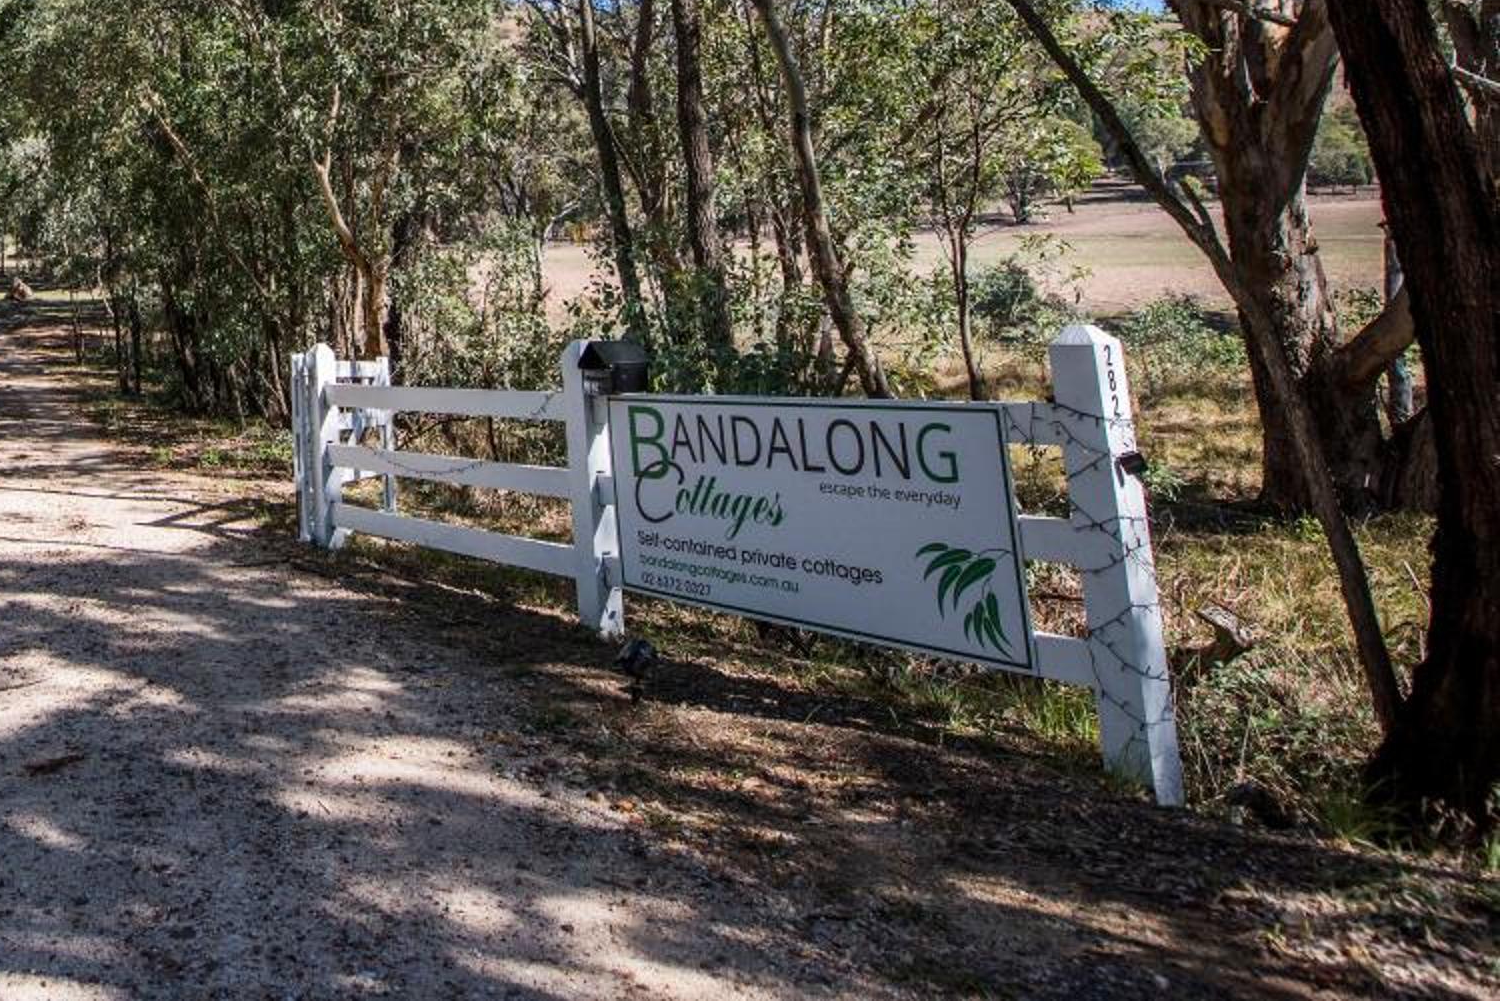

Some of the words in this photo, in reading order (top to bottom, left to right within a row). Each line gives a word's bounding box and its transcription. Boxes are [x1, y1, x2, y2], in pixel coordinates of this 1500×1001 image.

[1103, 344, 1121, 417] 282
[628, 405, 960, 484] BANDALONG
[635, 460, 785, 540] Cottages
[819, 483, 865, 501] escape
[866, 483, 891, 500] the
[895, 488, 962, 510] everyday
[637, 530, 737, 561] Self-contained
[741, 549, 797, 570] private
[801, 558, 884, 585] cottages
[639, 553, 800, 593] bandalongcottages.com.au
[641, 572, 654, 585] 02
